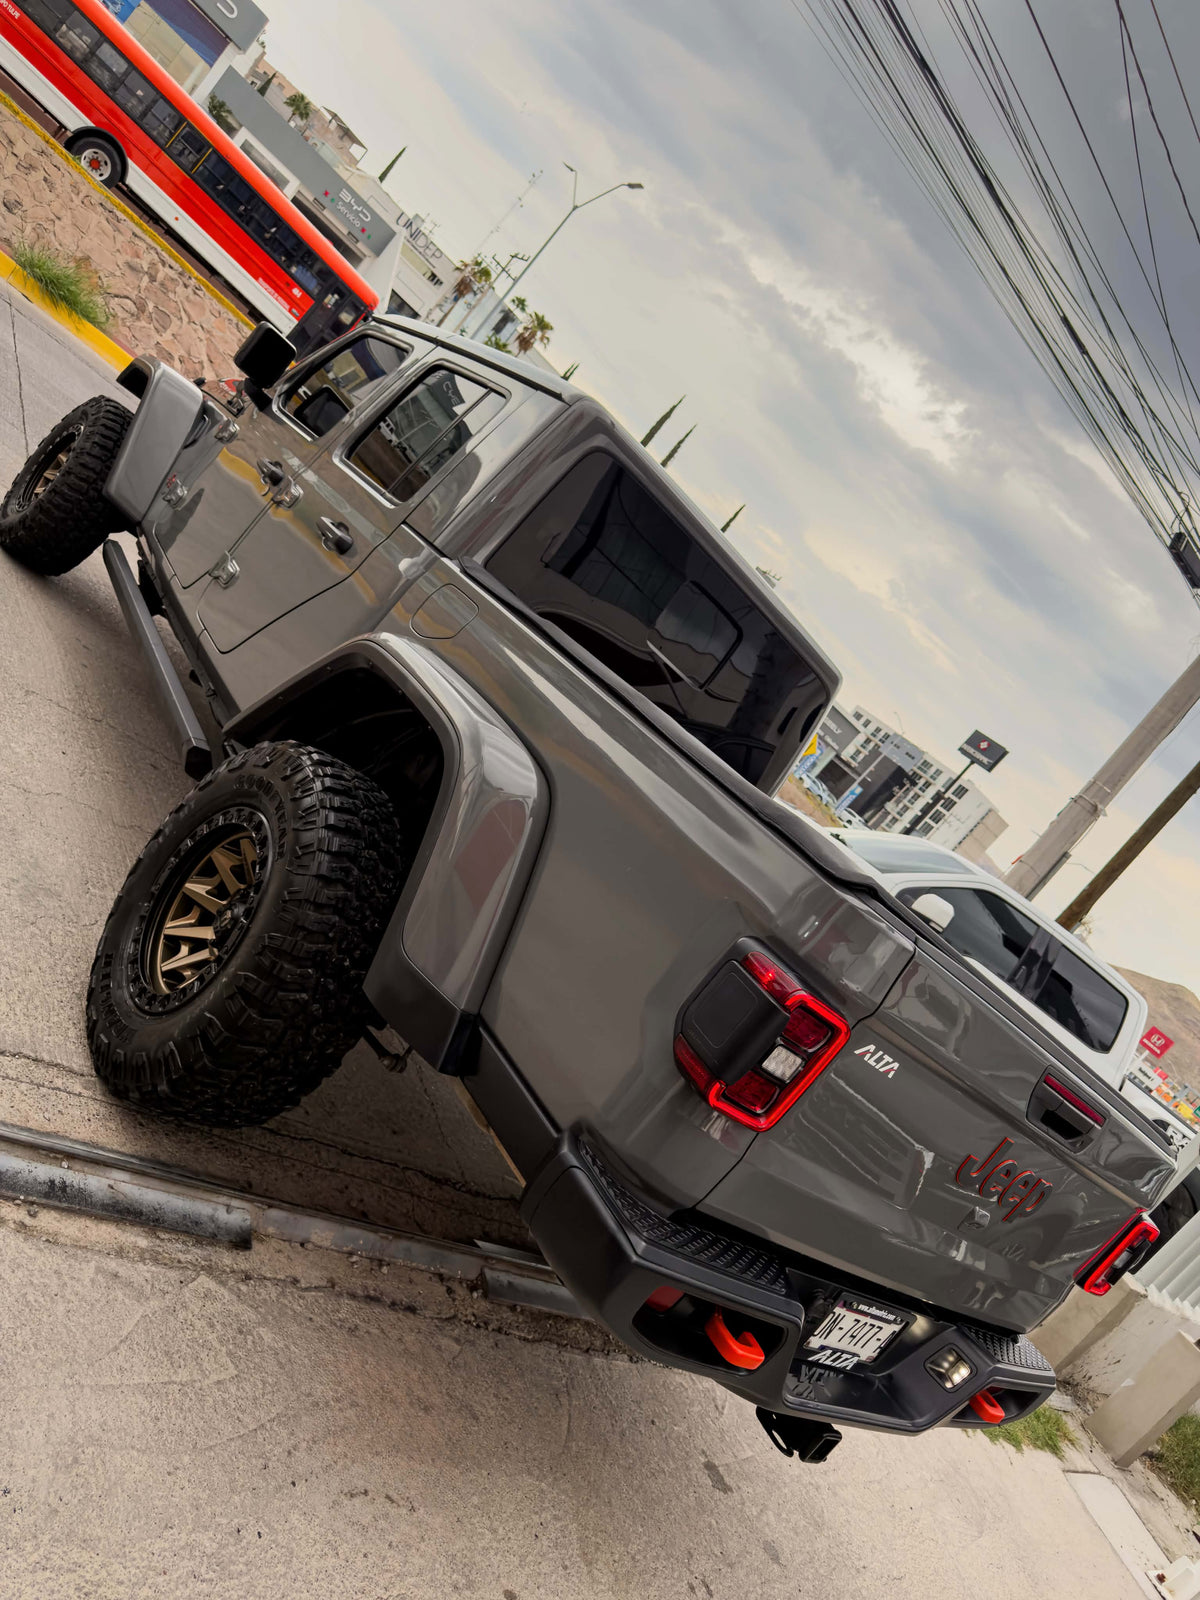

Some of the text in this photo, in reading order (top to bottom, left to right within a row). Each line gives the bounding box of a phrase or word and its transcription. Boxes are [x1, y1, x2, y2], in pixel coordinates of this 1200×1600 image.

[337, 201, 361, 228] Servicio
[339, 188, 371, 222] BYD
[396, 211, 443, 260] UNIDEP
[854, 1044, 900, 1079] ALTA
[956, 1137, 1053, 1224] Jeep
[808, 1349, 860, 1371] ALTA
